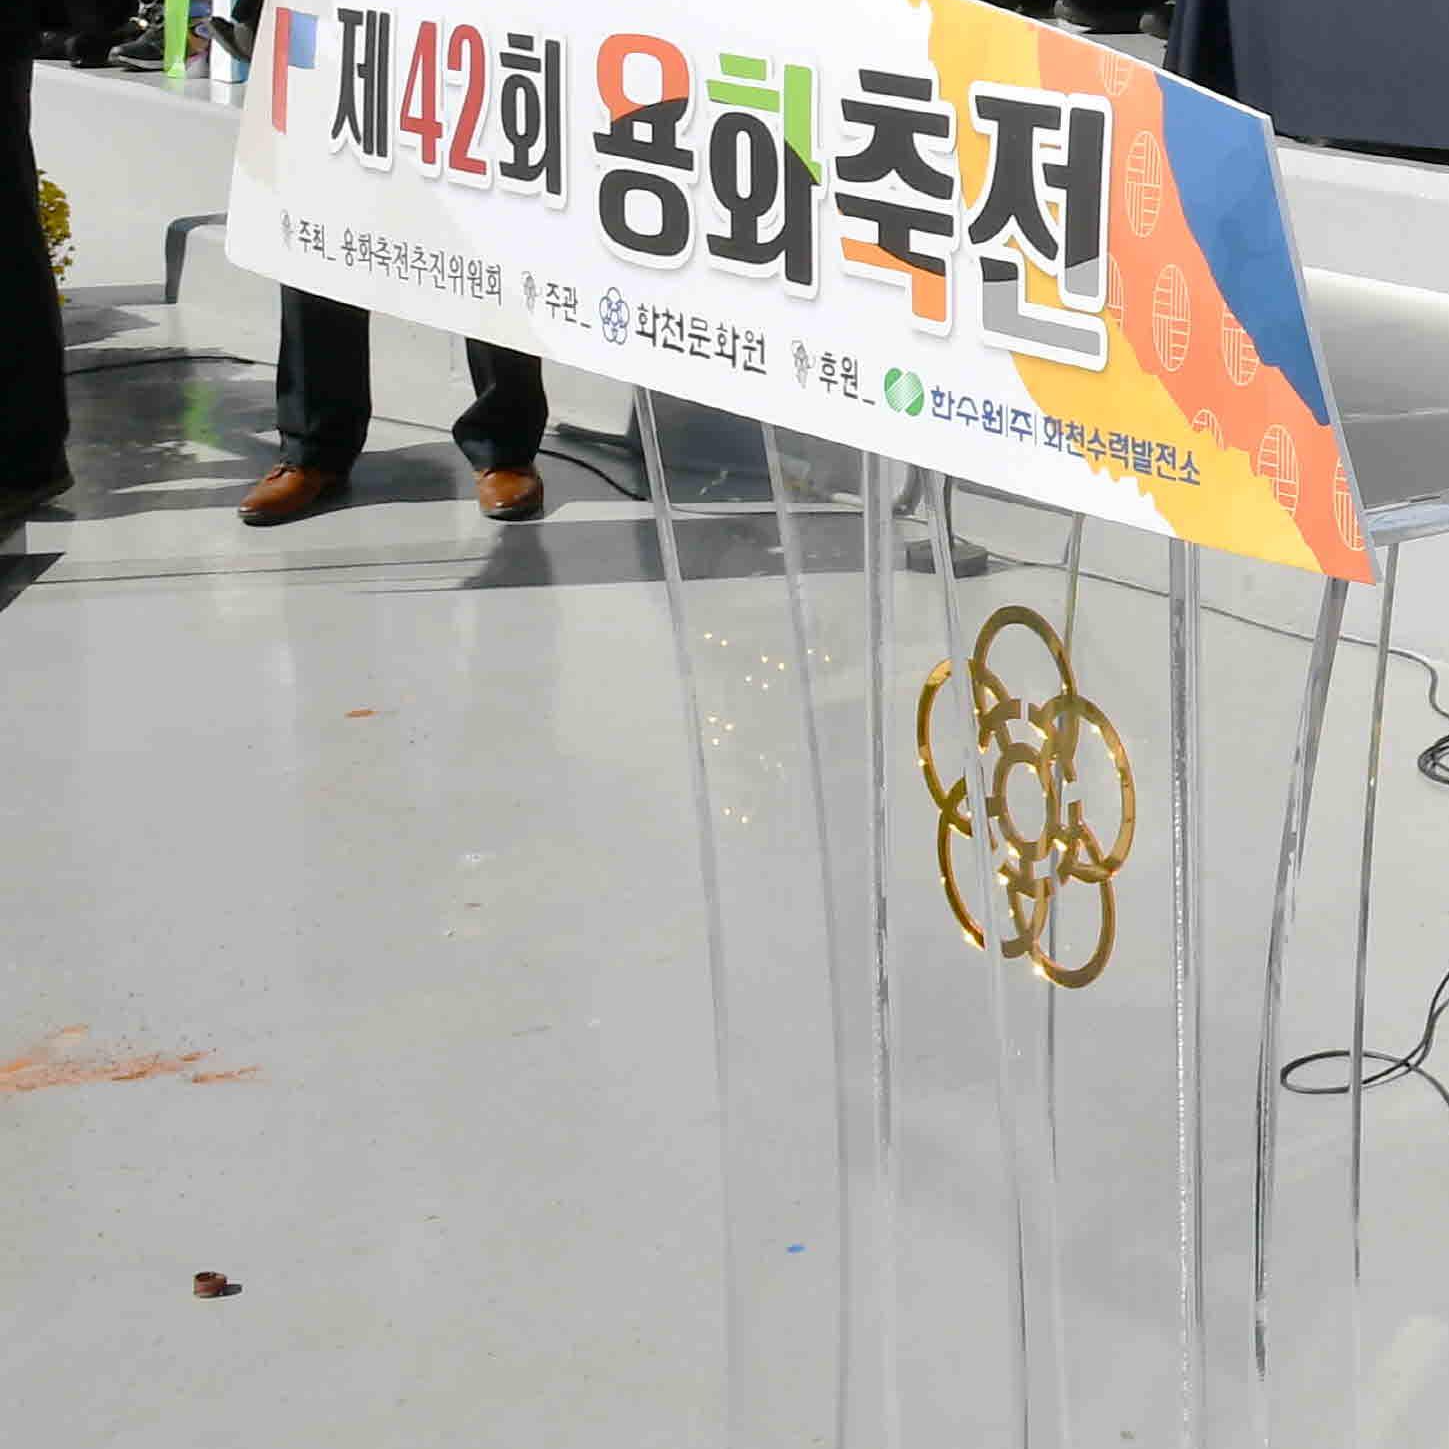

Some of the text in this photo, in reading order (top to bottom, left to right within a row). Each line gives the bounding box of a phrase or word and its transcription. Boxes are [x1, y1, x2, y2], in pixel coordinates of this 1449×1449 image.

[331, 7, 1106, 355] 제42회 용화축전
[341, 227, 502, 308] 용화축전추진위원회
[635, 302, 767, 376] 화천문화원
[1043, 414, 1201, 486] 화천수력발전소
